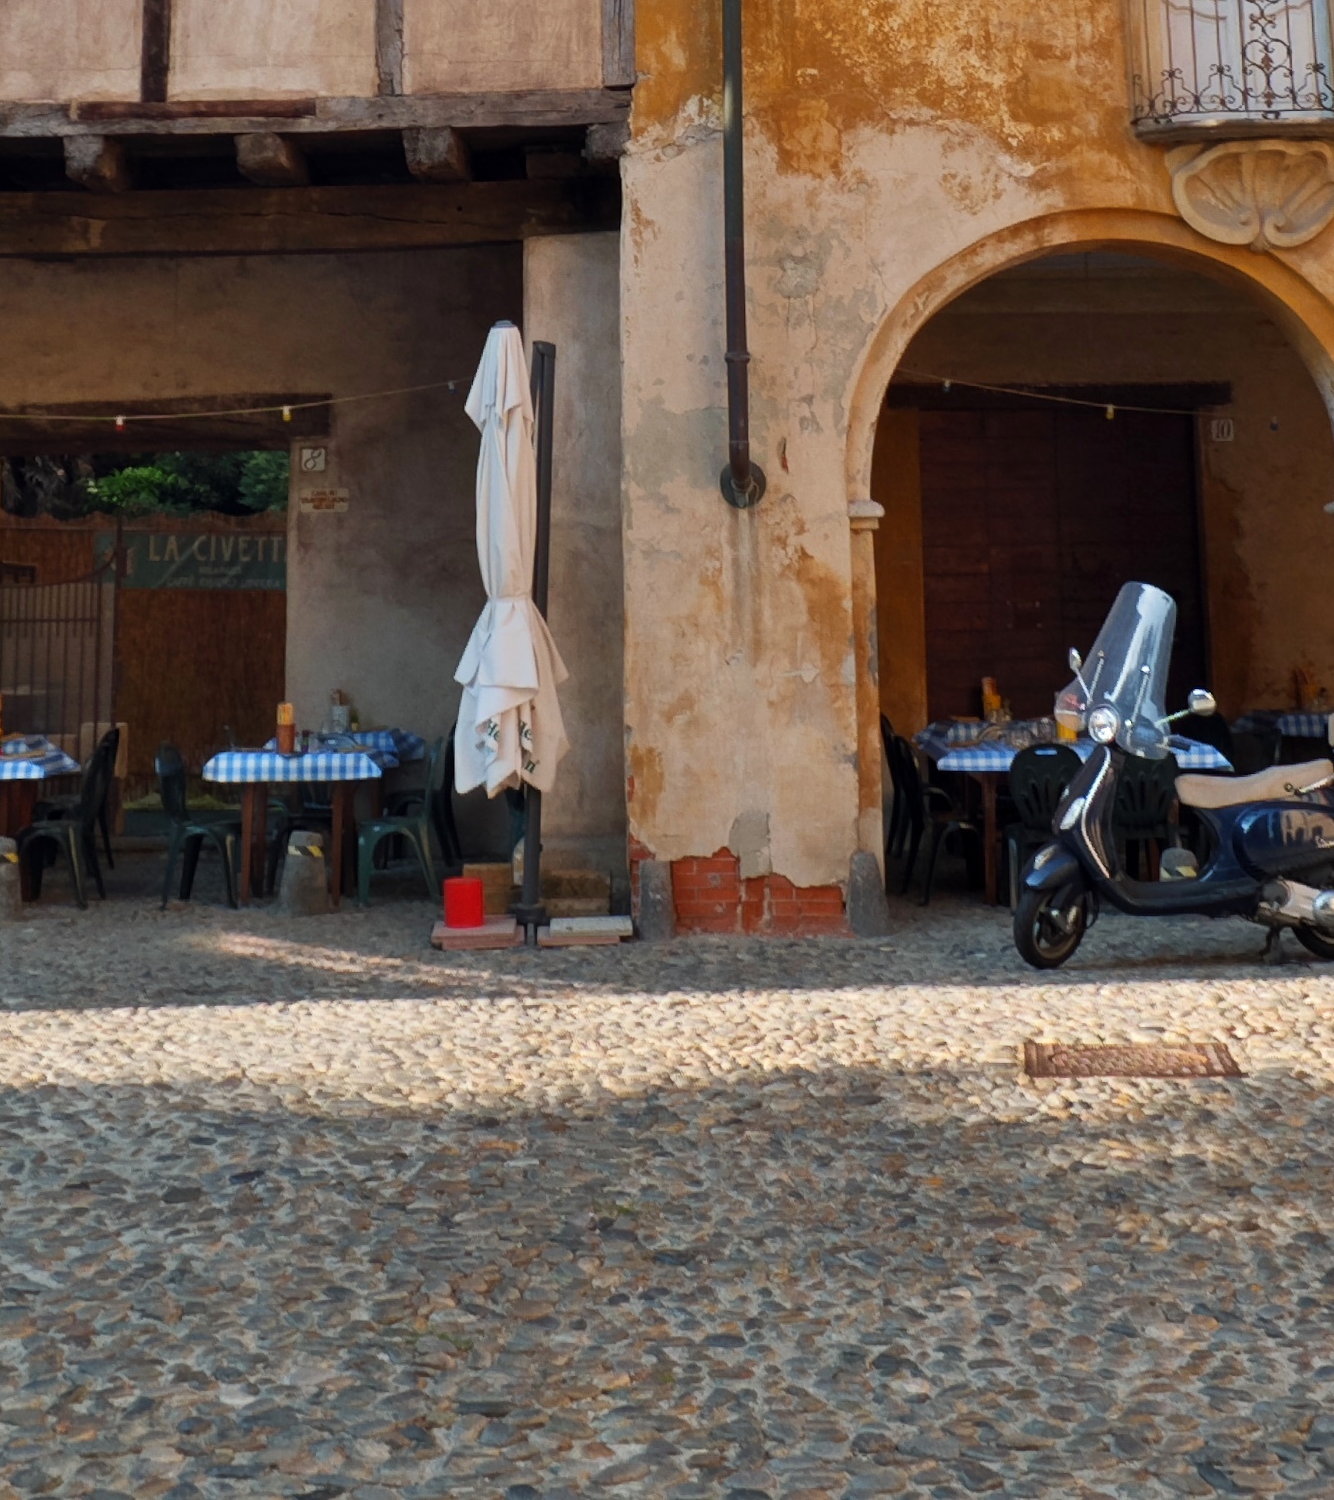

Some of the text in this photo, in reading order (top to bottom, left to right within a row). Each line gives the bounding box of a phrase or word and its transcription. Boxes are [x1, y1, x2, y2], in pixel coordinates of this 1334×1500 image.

[303, 449, 323, 471] 8
[148, 533, 287, 563] LA CIVETT
